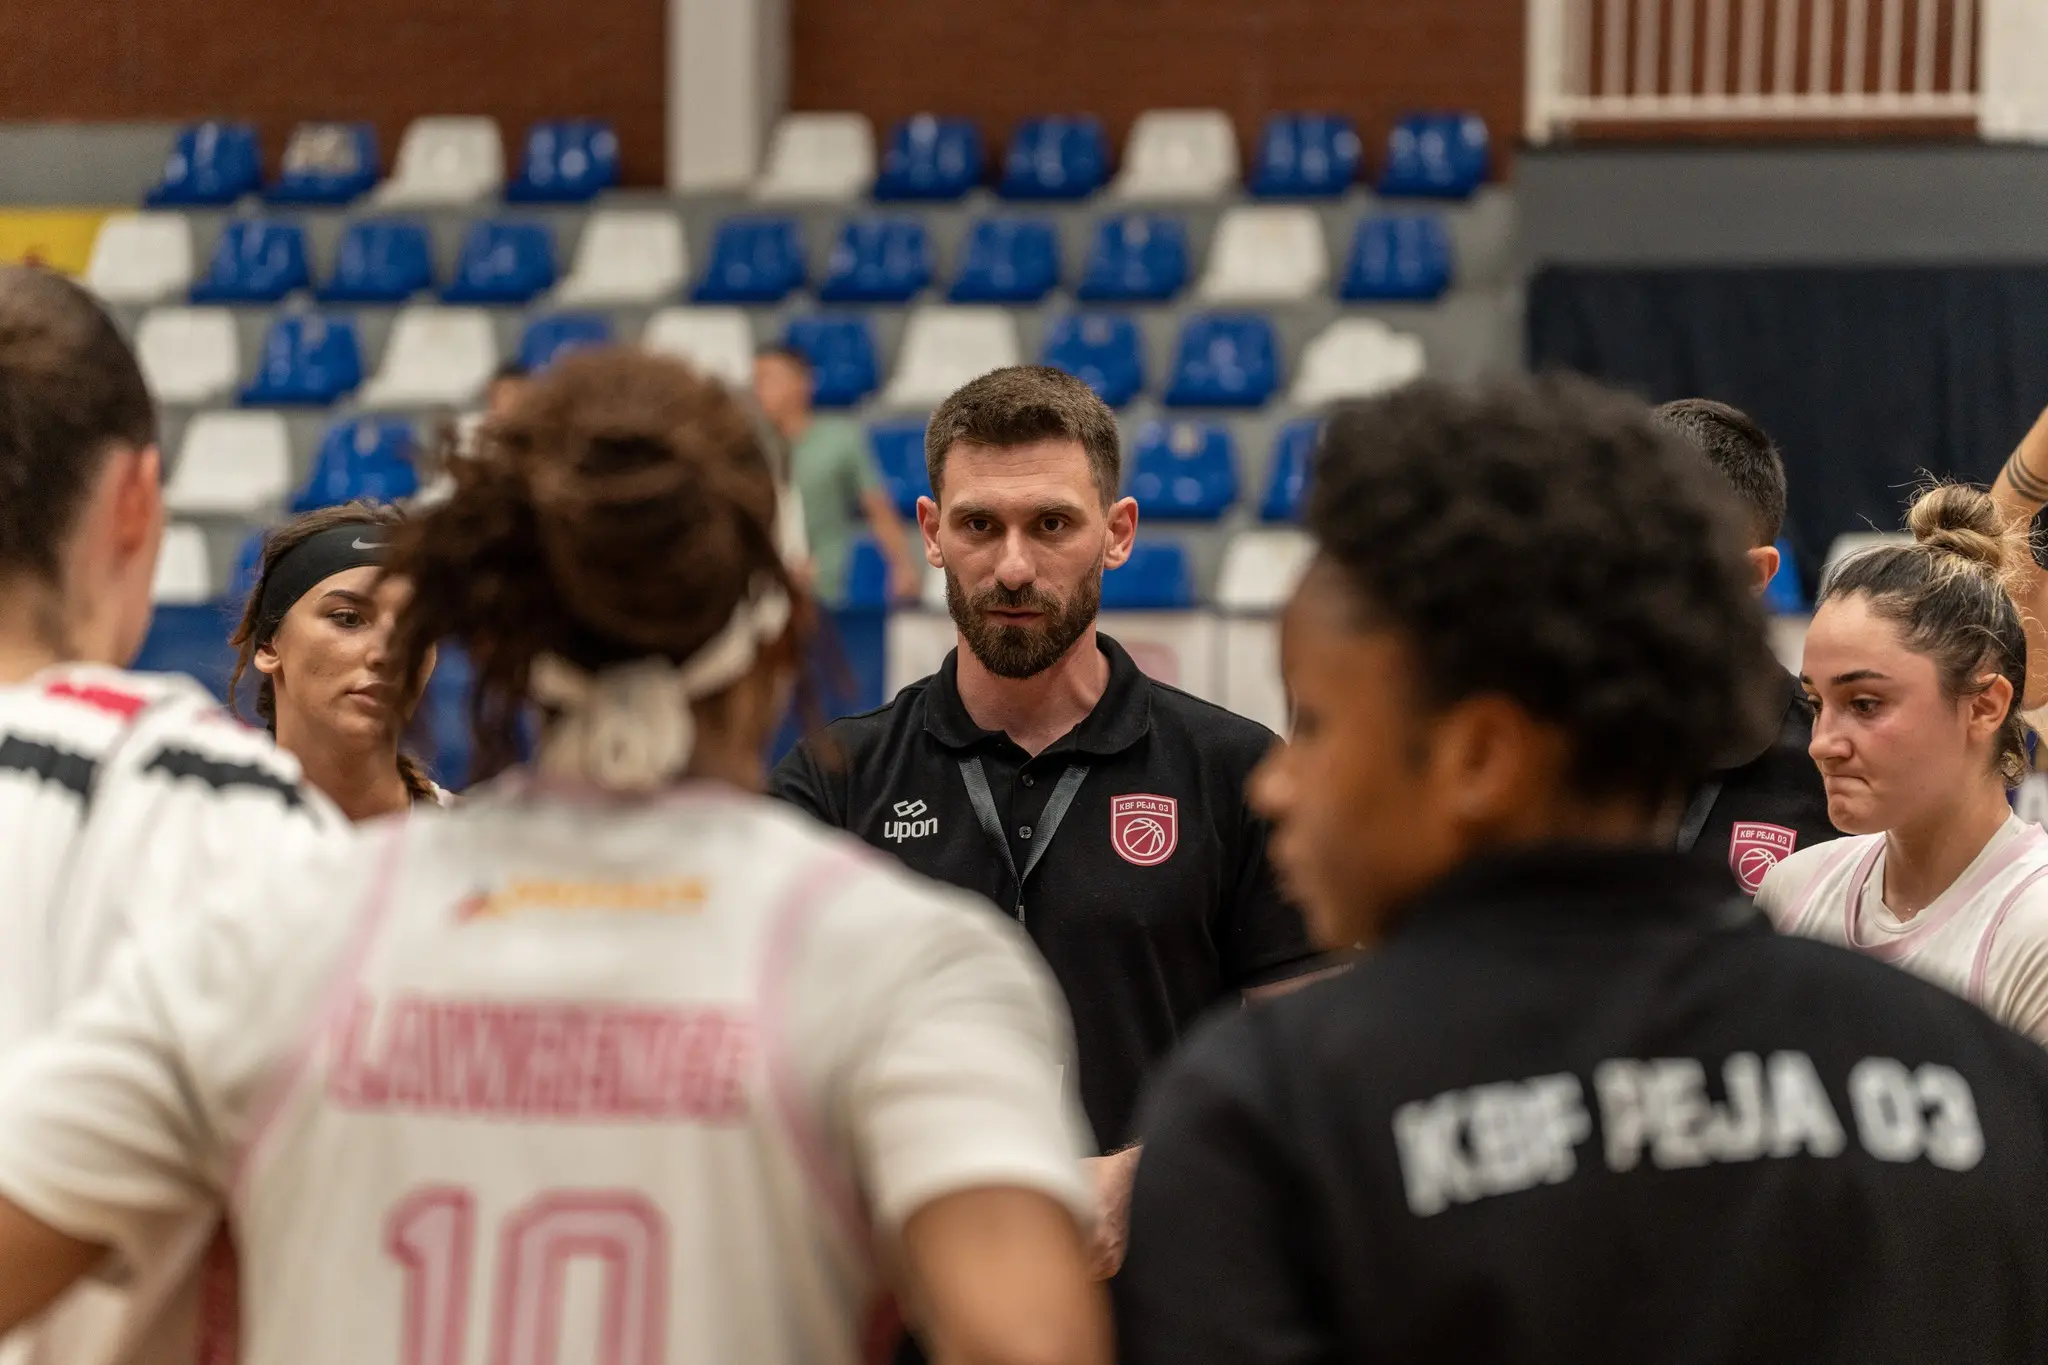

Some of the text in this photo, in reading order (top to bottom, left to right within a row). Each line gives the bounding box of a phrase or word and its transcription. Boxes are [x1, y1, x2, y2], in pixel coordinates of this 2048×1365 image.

[1119, 801, 1169, 812] KBF PEJA 03
[884, 817, 938, 843] upon
[1740, 830, 1788, 844] KBF PEJA 03
[1393, 1050, 1984, 1217] KBF PEJA 03
